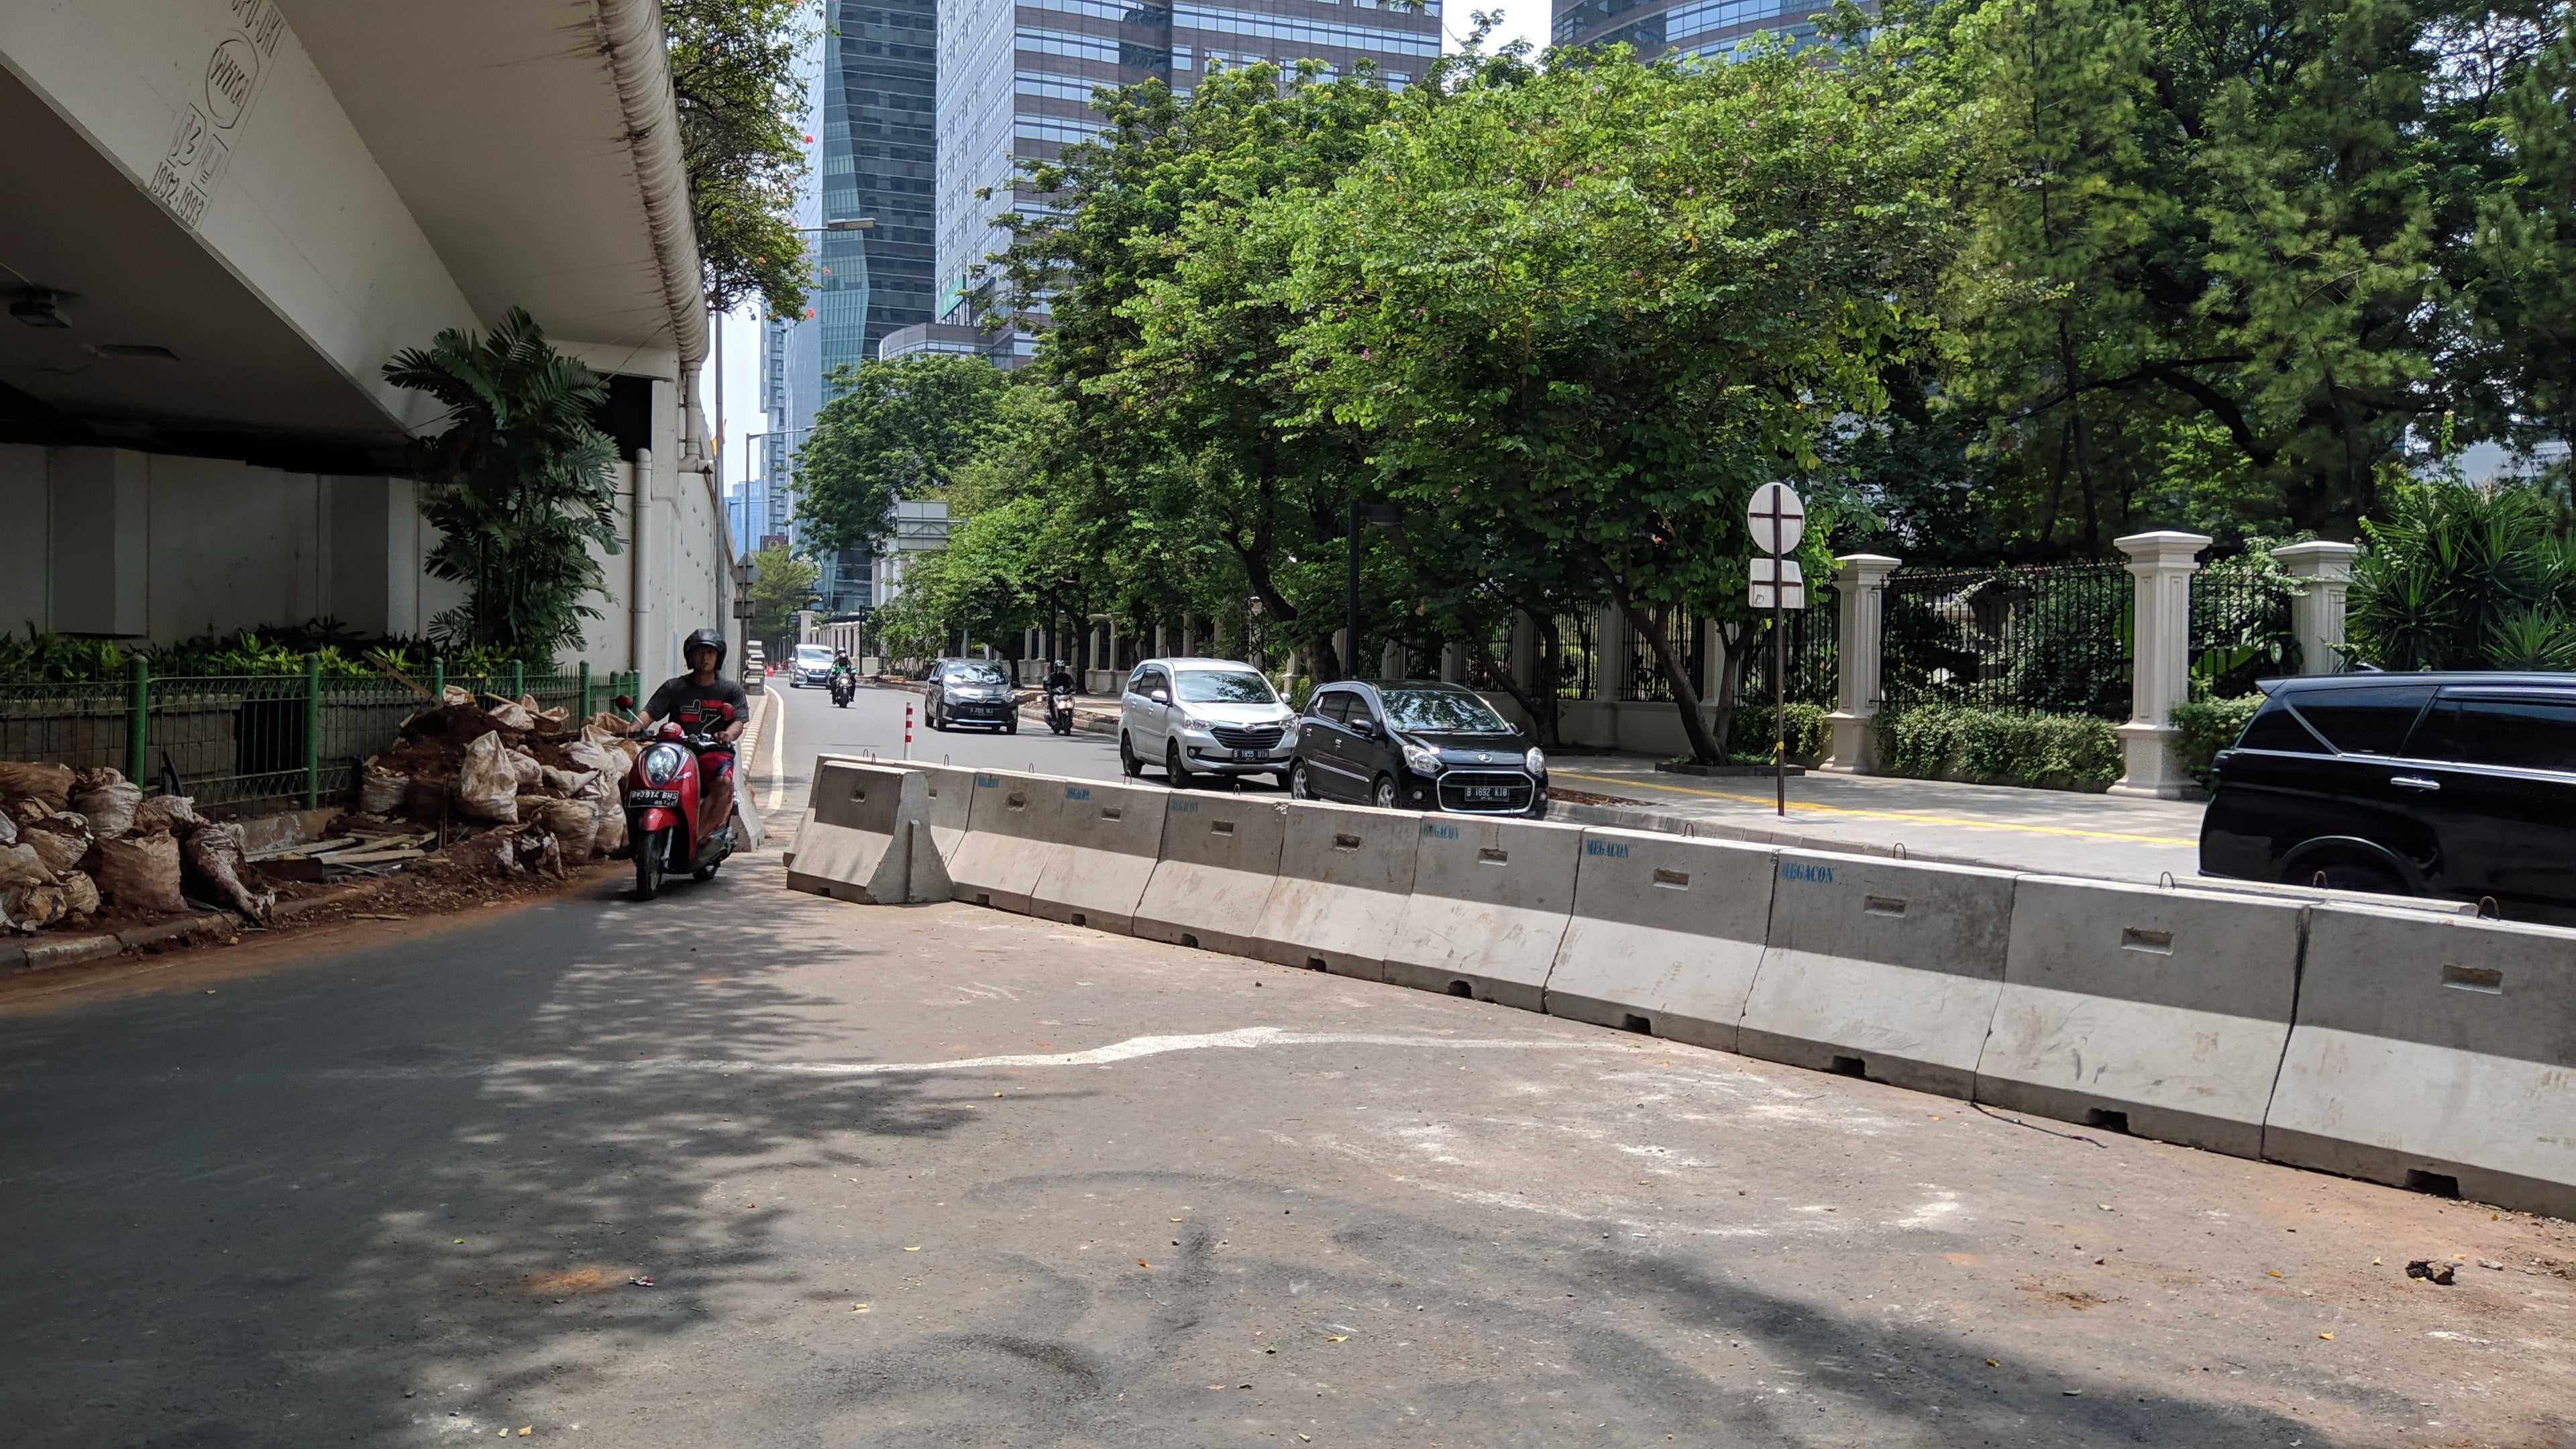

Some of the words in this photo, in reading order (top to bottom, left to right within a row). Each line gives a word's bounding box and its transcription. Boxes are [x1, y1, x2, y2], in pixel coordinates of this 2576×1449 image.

[1234, 750, 1238, 758] B
[1466, 788, 1472, 797] B
[1476, 788, 1491, 797] 1692
[1587, 839, 1629, 858] MEGACON
[1781, 863, 1833, 883] MEGACON
